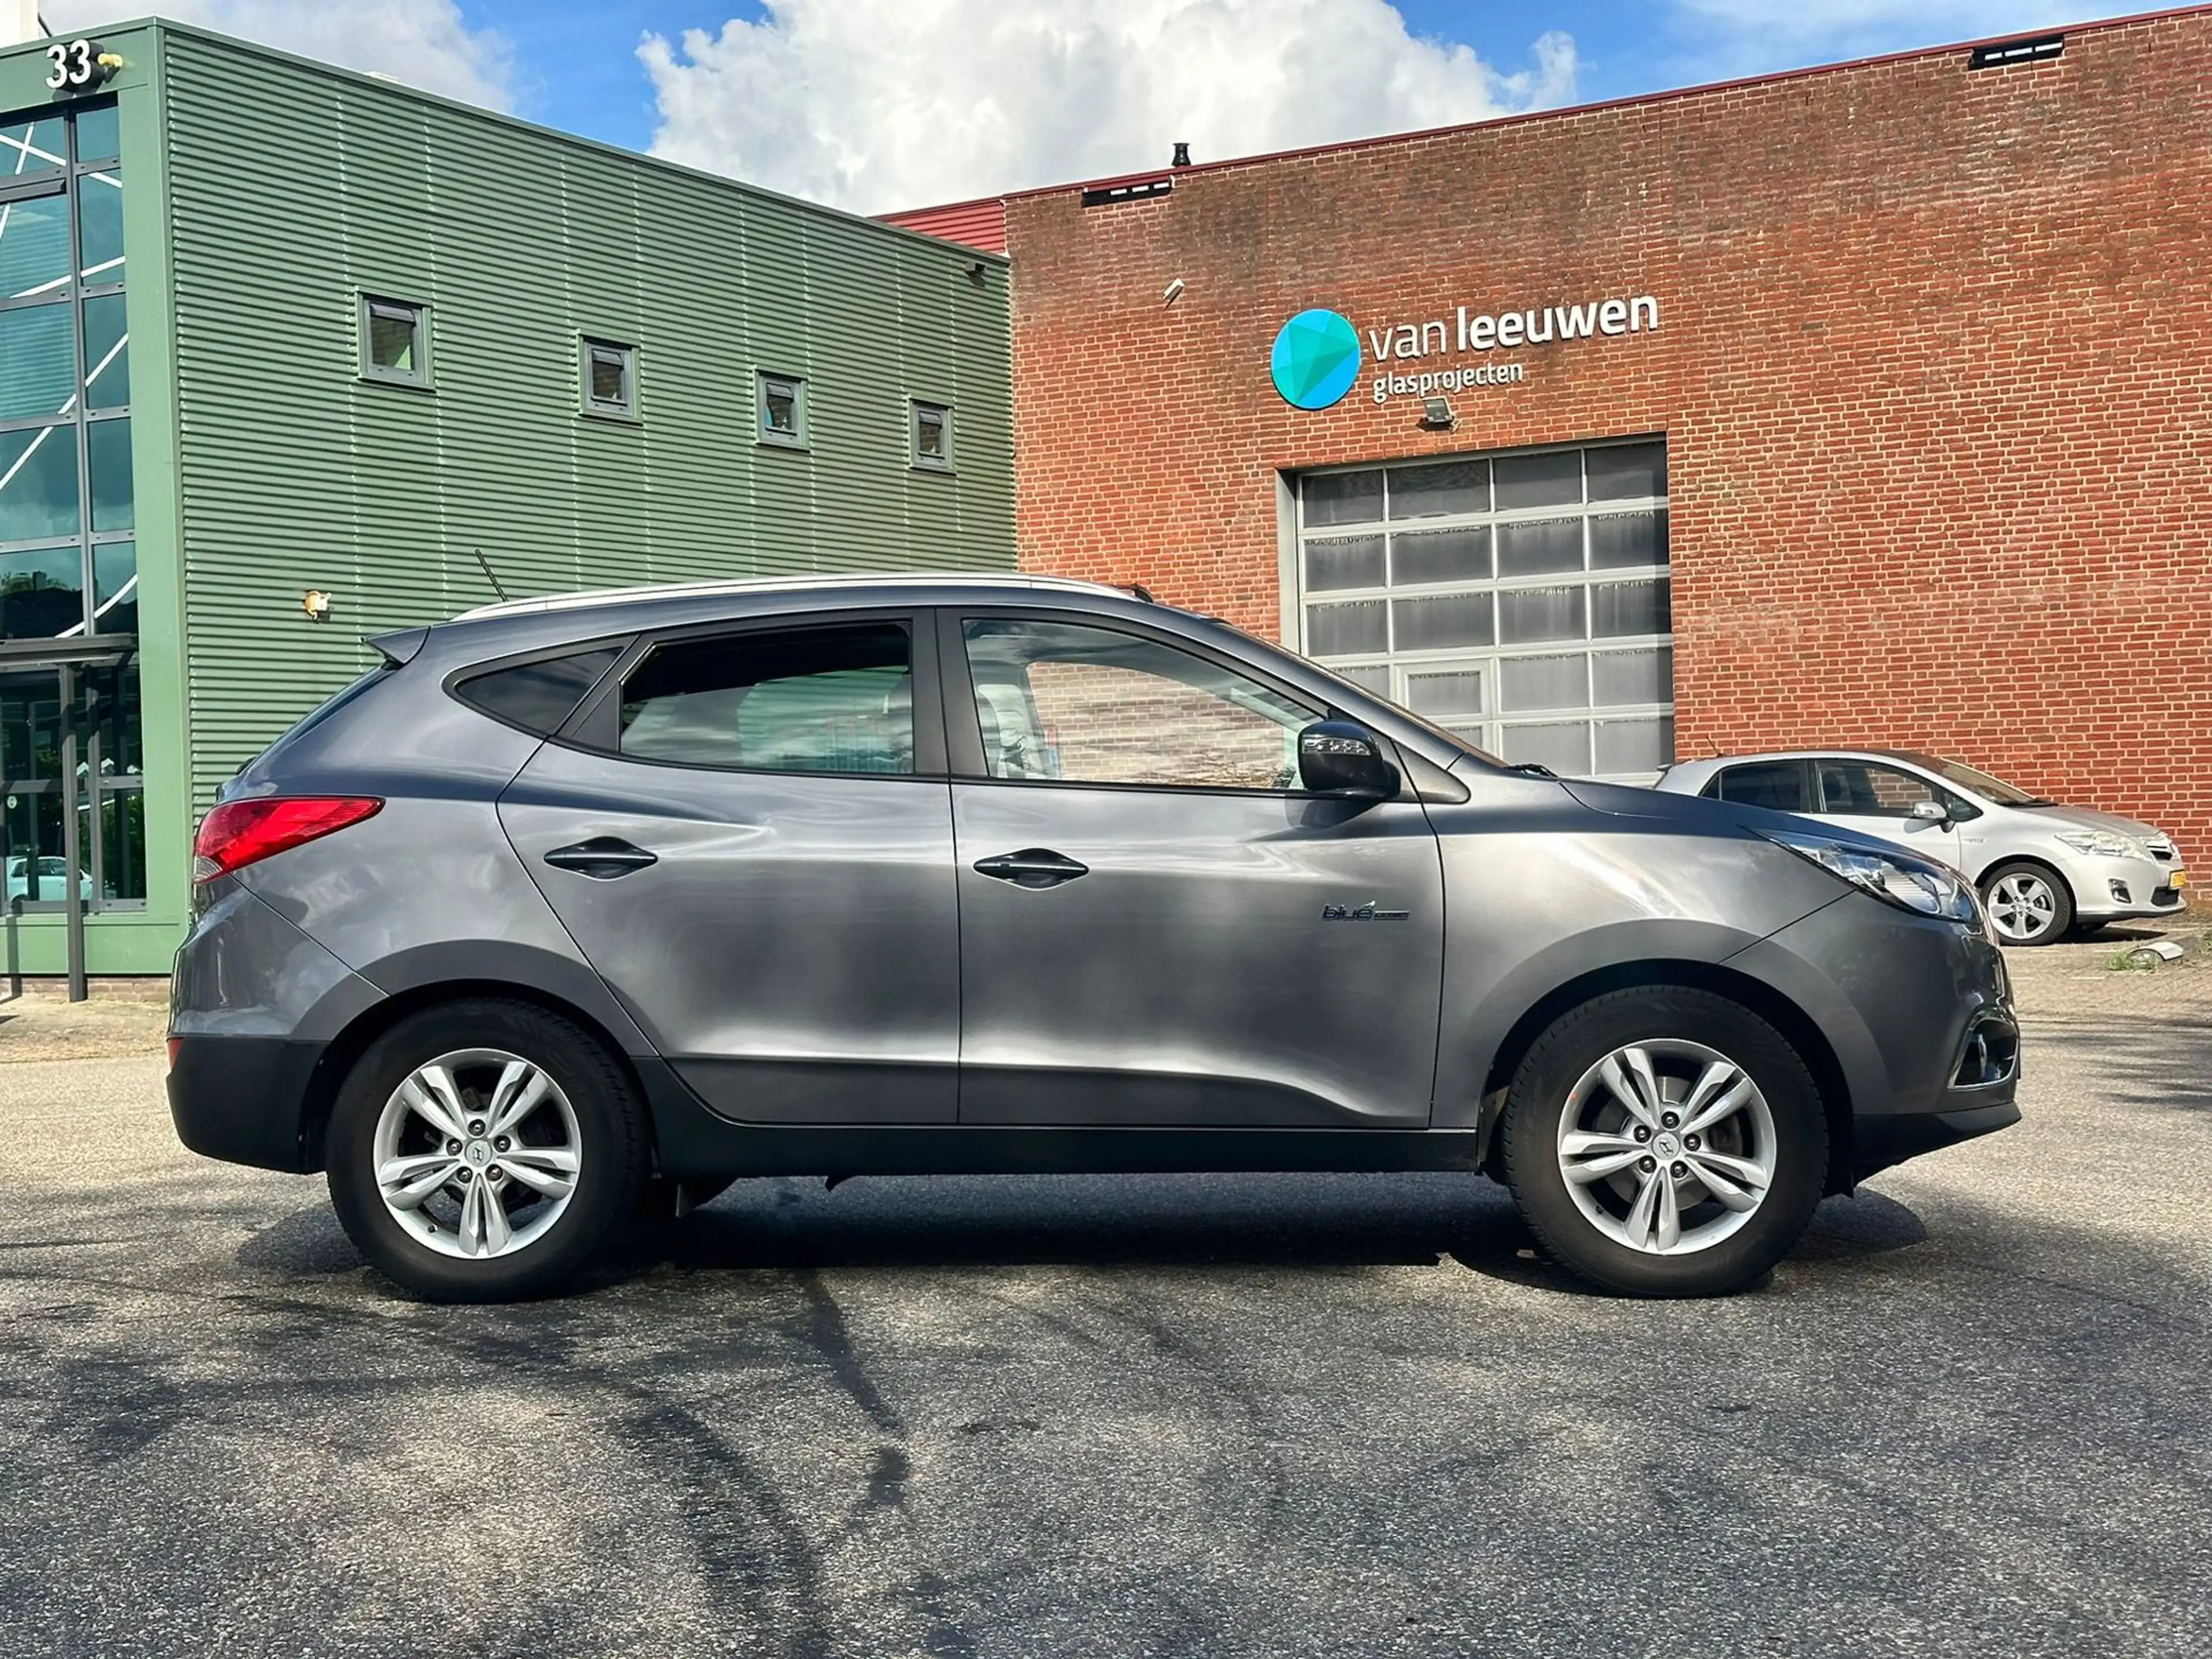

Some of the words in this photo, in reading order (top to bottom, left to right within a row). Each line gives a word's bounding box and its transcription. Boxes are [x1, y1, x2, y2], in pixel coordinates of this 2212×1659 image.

[46, 39, 91, 89] 33
[1368, 320, 1447, 362] van
[1457, 295, 1658, 351] leeuwen
[1372, 362, 1524, 403] glasprojecten
